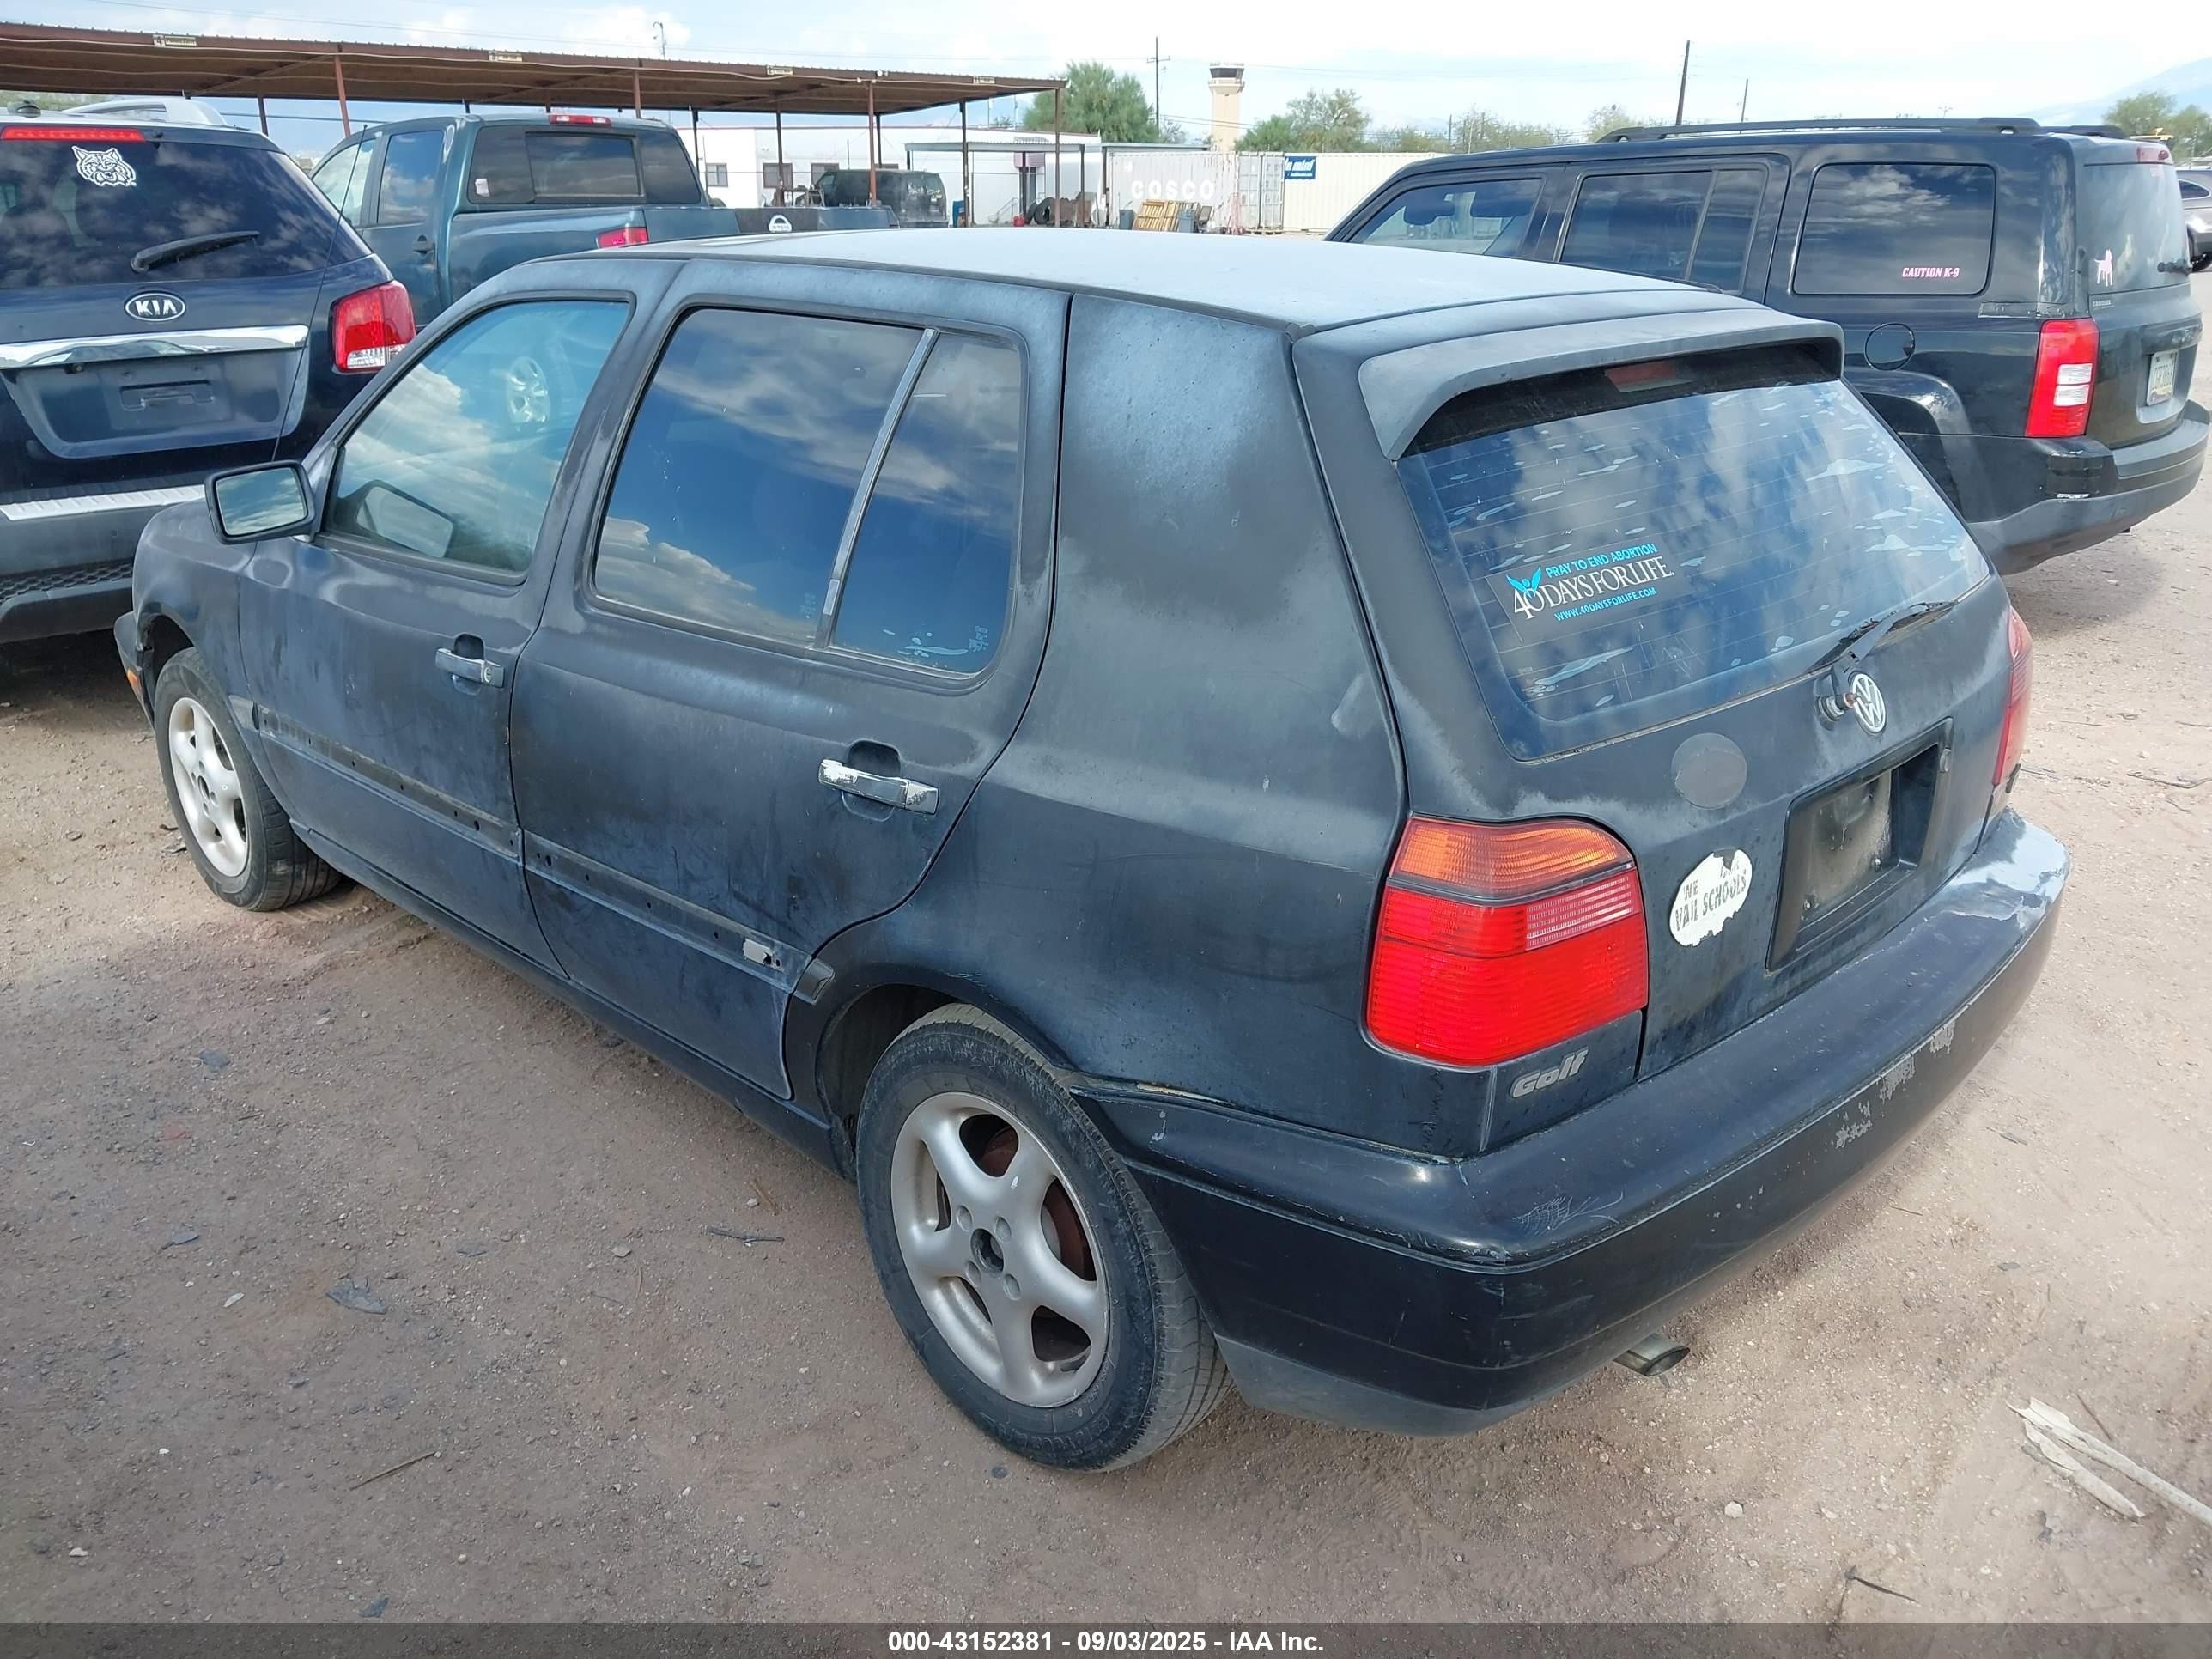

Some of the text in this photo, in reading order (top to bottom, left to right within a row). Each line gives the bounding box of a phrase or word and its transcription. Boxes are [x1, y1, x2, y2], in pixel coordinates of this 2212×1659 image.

[1132, 179, 1215, 199] COSCO
[1901, 267, 1960, 277] CAUTION K-9
[135, 299, 178, 316] KIA
[1546, 543, 1658, 578] PRAY TO END ABORTION
[1554, 587, 1657, 622] WWW.40DAYSFORLIFE.COM
[1675, 873, 1747, 932] VAIL SCHOOLS
[1510, 1047, 1589, 1098] Golf
